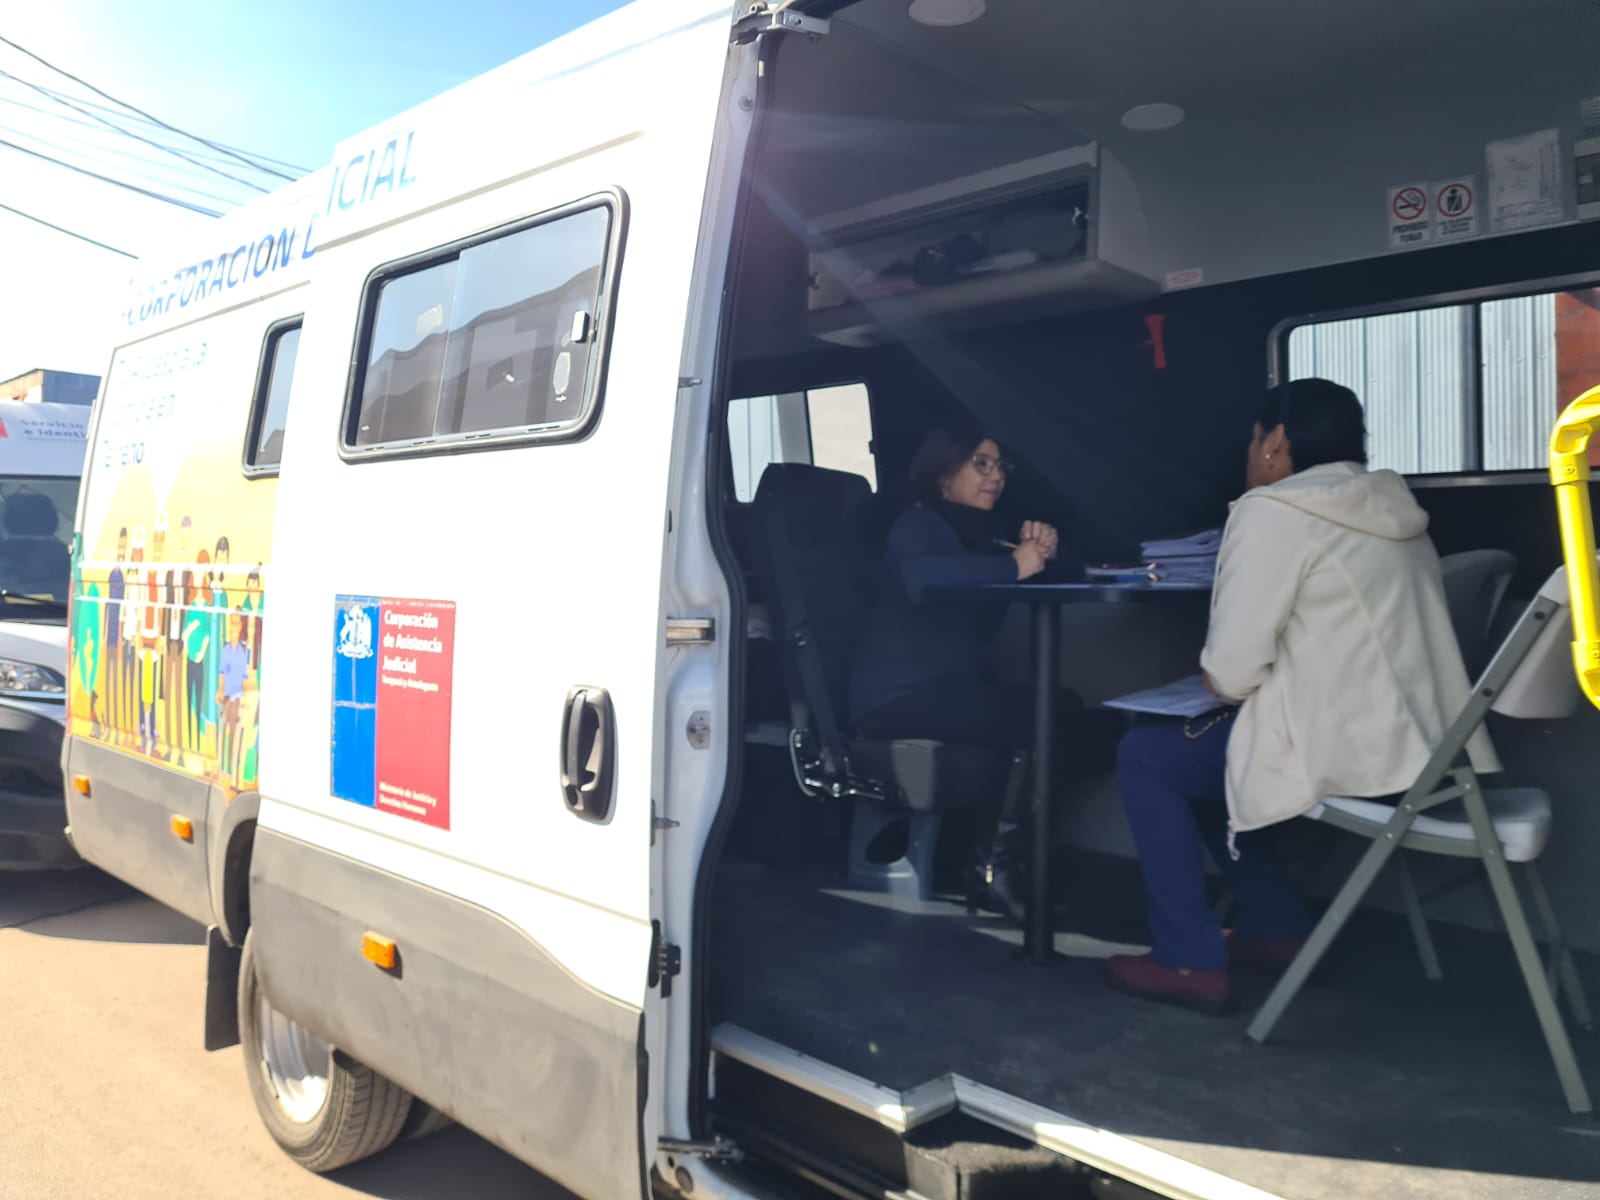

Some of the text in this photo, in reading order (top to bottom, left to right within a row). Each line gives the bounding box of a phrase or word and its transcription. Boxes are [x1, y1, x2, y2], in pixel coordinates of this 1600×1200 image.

[383, 632, 443, 654] de Asistencia
[382, 655, 417, 675] Judicial
